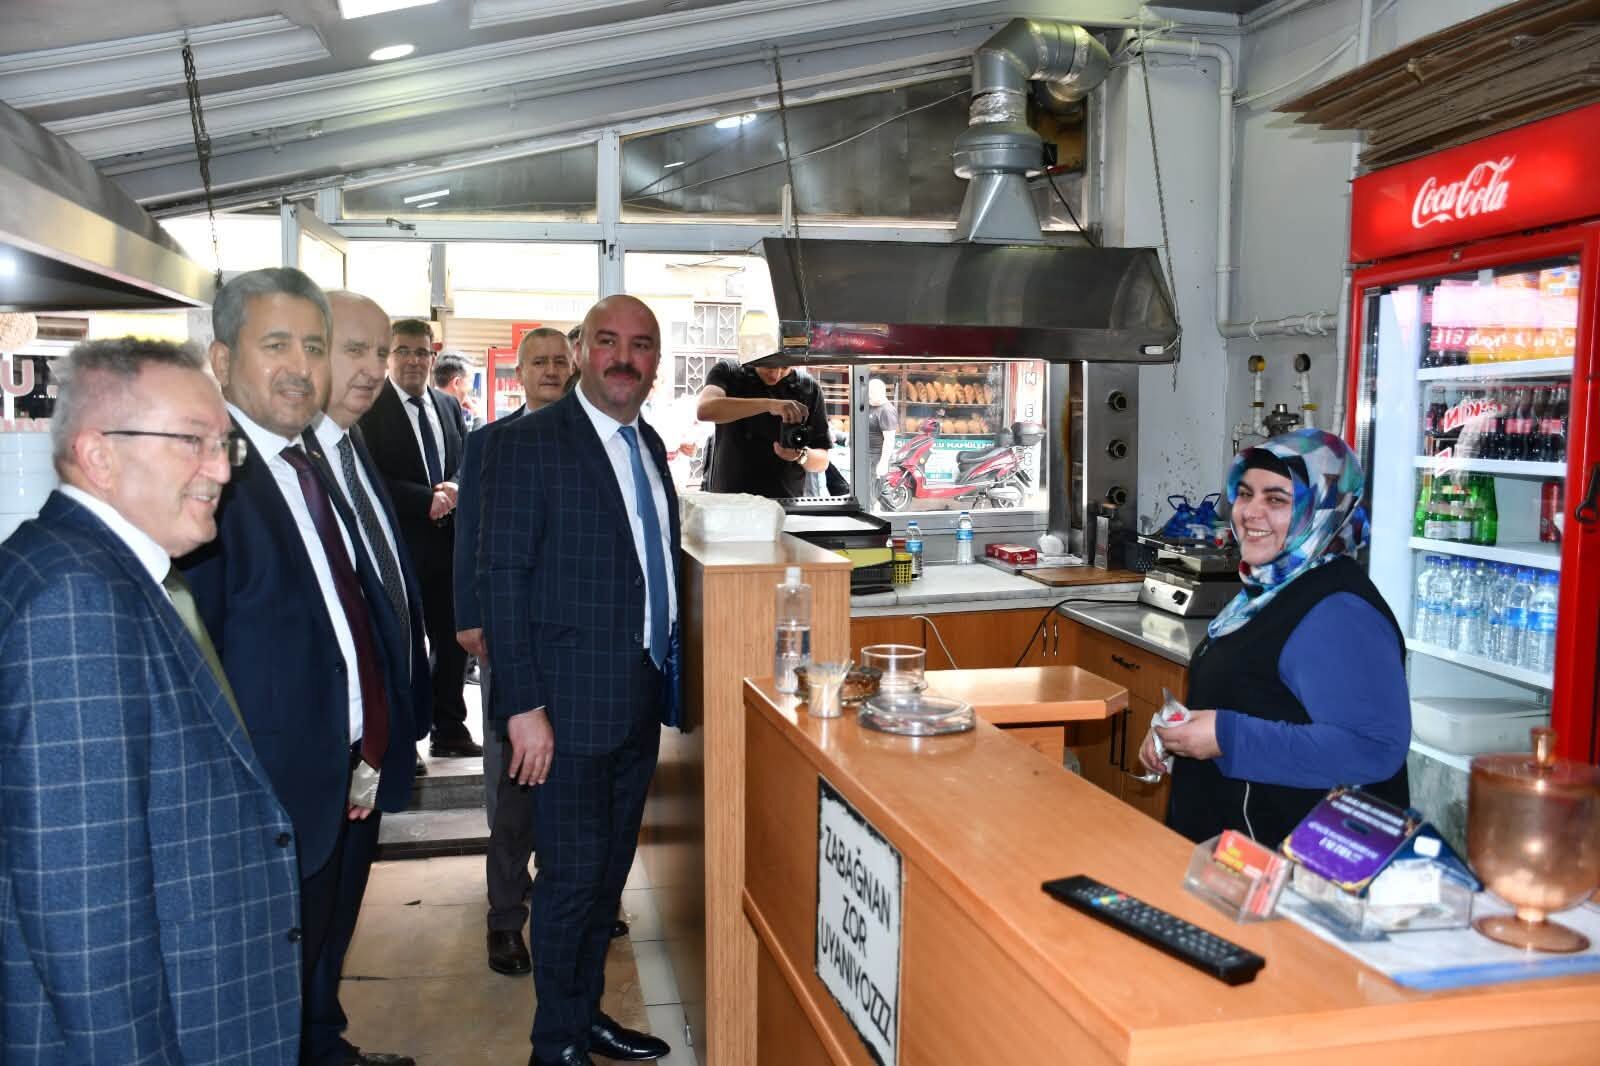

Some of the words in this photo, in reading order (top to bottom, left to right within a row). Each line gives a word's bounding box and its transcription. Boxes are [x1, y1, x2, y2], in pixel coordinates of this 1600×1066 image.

[825, 824, 891, 933] ZABAĞNAN
[842, 894, 867, 958] ZOR
[820, 914, 892, 1047] UYANIYOZZZ
